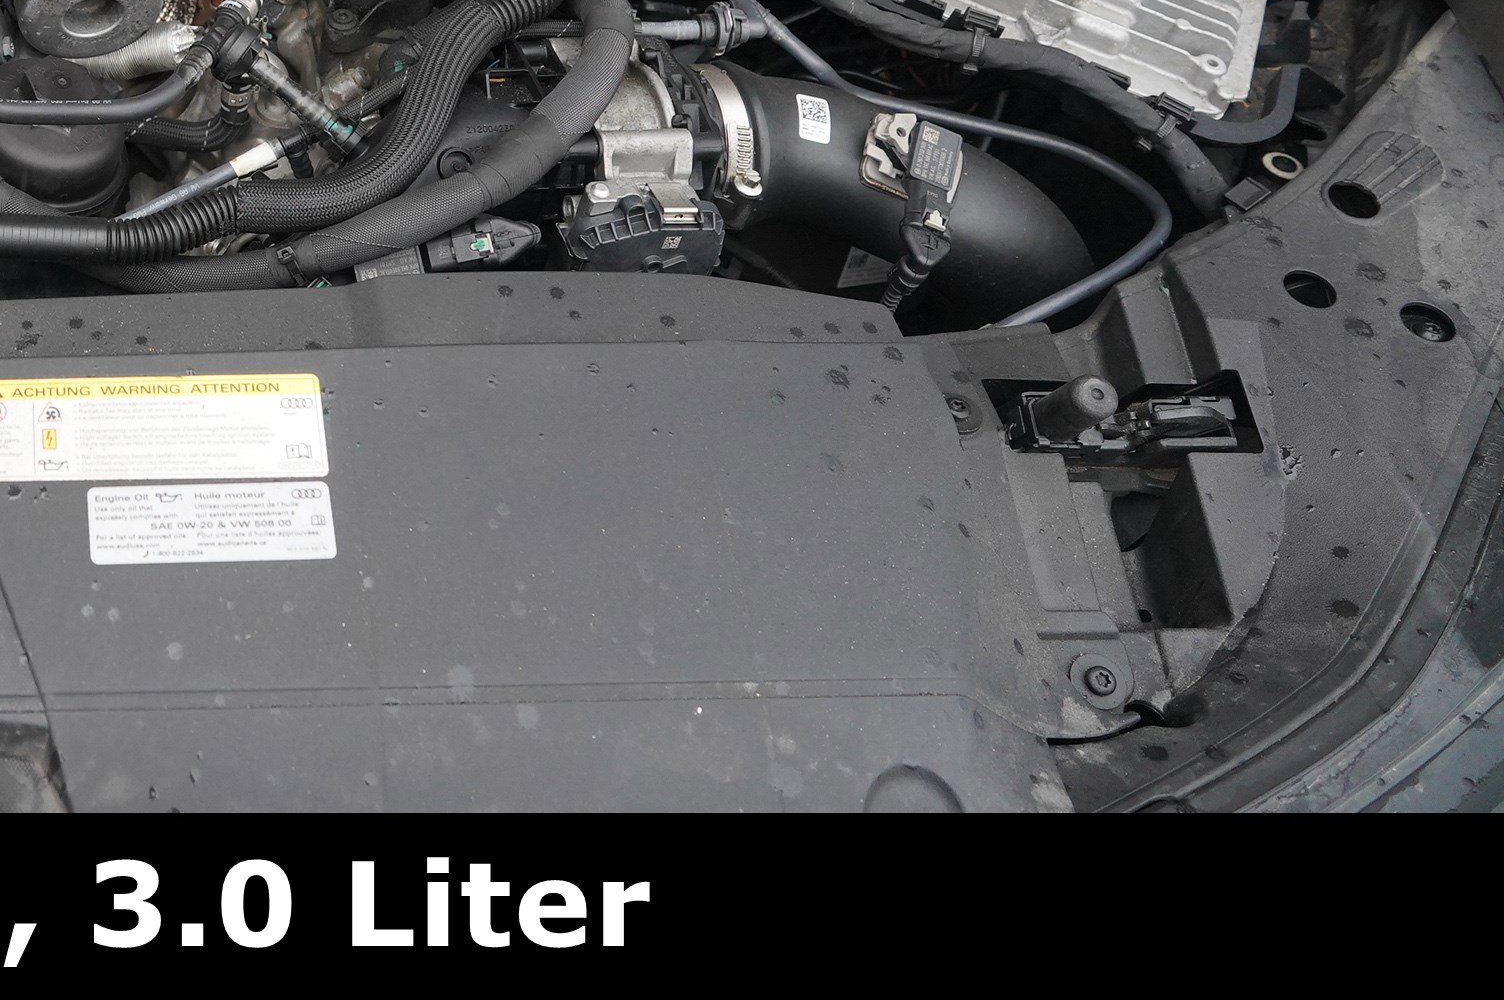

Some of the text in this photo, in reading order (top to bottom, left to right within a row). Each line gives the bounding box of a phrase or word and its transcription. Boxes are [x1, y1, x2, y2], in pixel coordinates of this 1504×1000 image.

[12, 382, 280, 398] ACHTUNG WARNING ATTENTION
[94, 494, 149, 504] Engine Oil
[194, 491, 266, 500] Huile moteur
[230, 520, 250, 528] VW
[277, 519, 292, 527] 00
